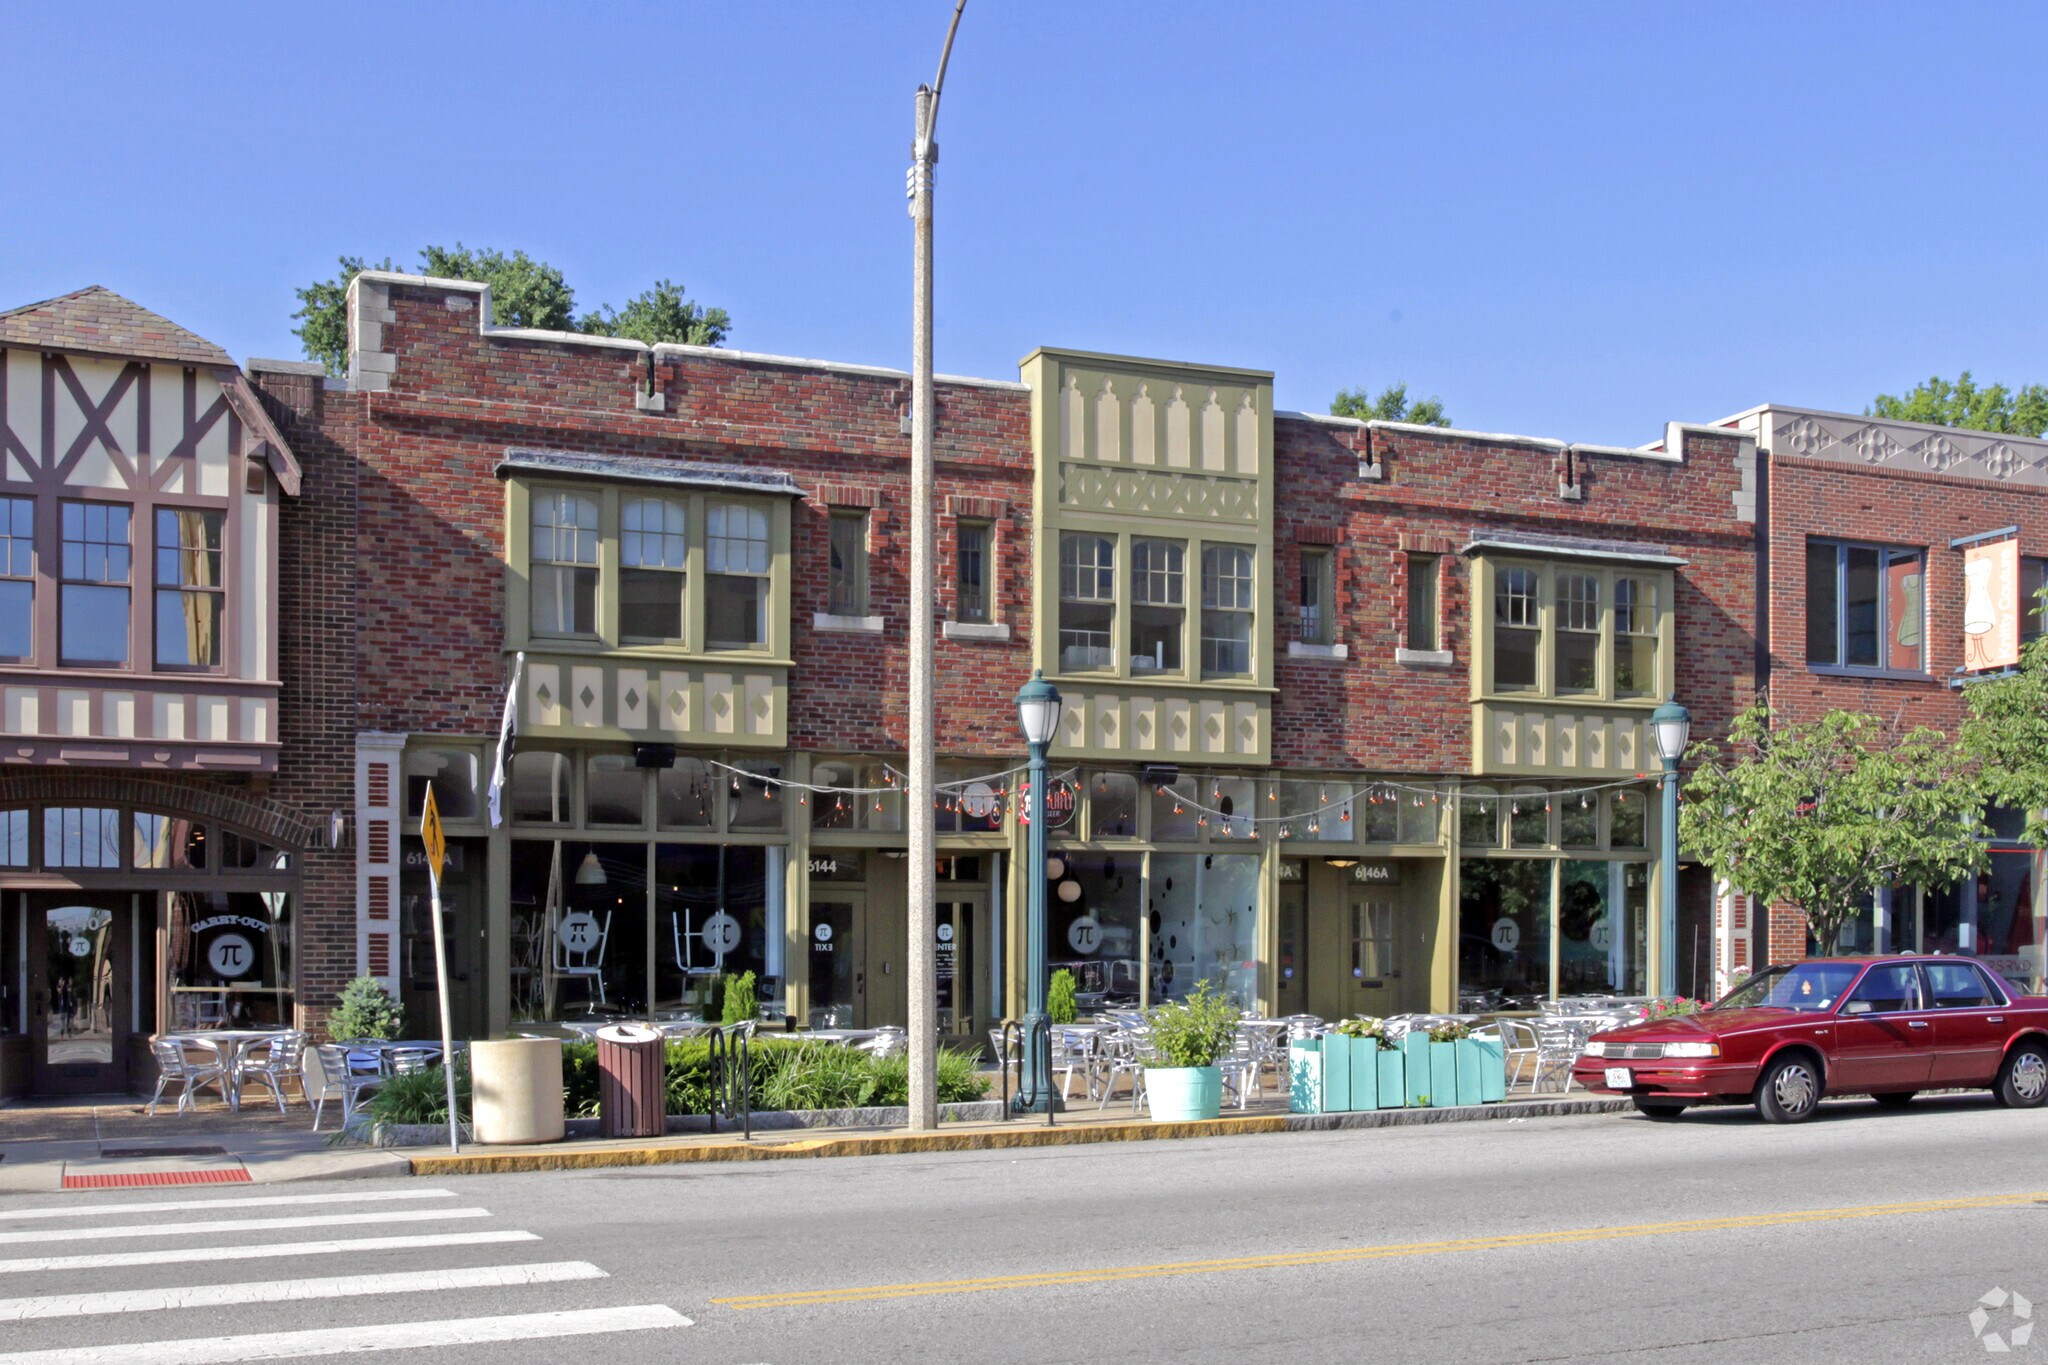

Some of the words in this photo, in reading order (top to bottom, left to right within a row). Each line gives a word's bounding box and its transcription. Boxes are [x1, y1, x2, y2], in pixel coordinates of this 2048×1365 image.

[406, 852, 453, 865] 614A
[808, 860, 837, 873] 6144
[1355, 867, 1389, 879] 6146A
[191, 914, 270, 933] CARRY-OUT
